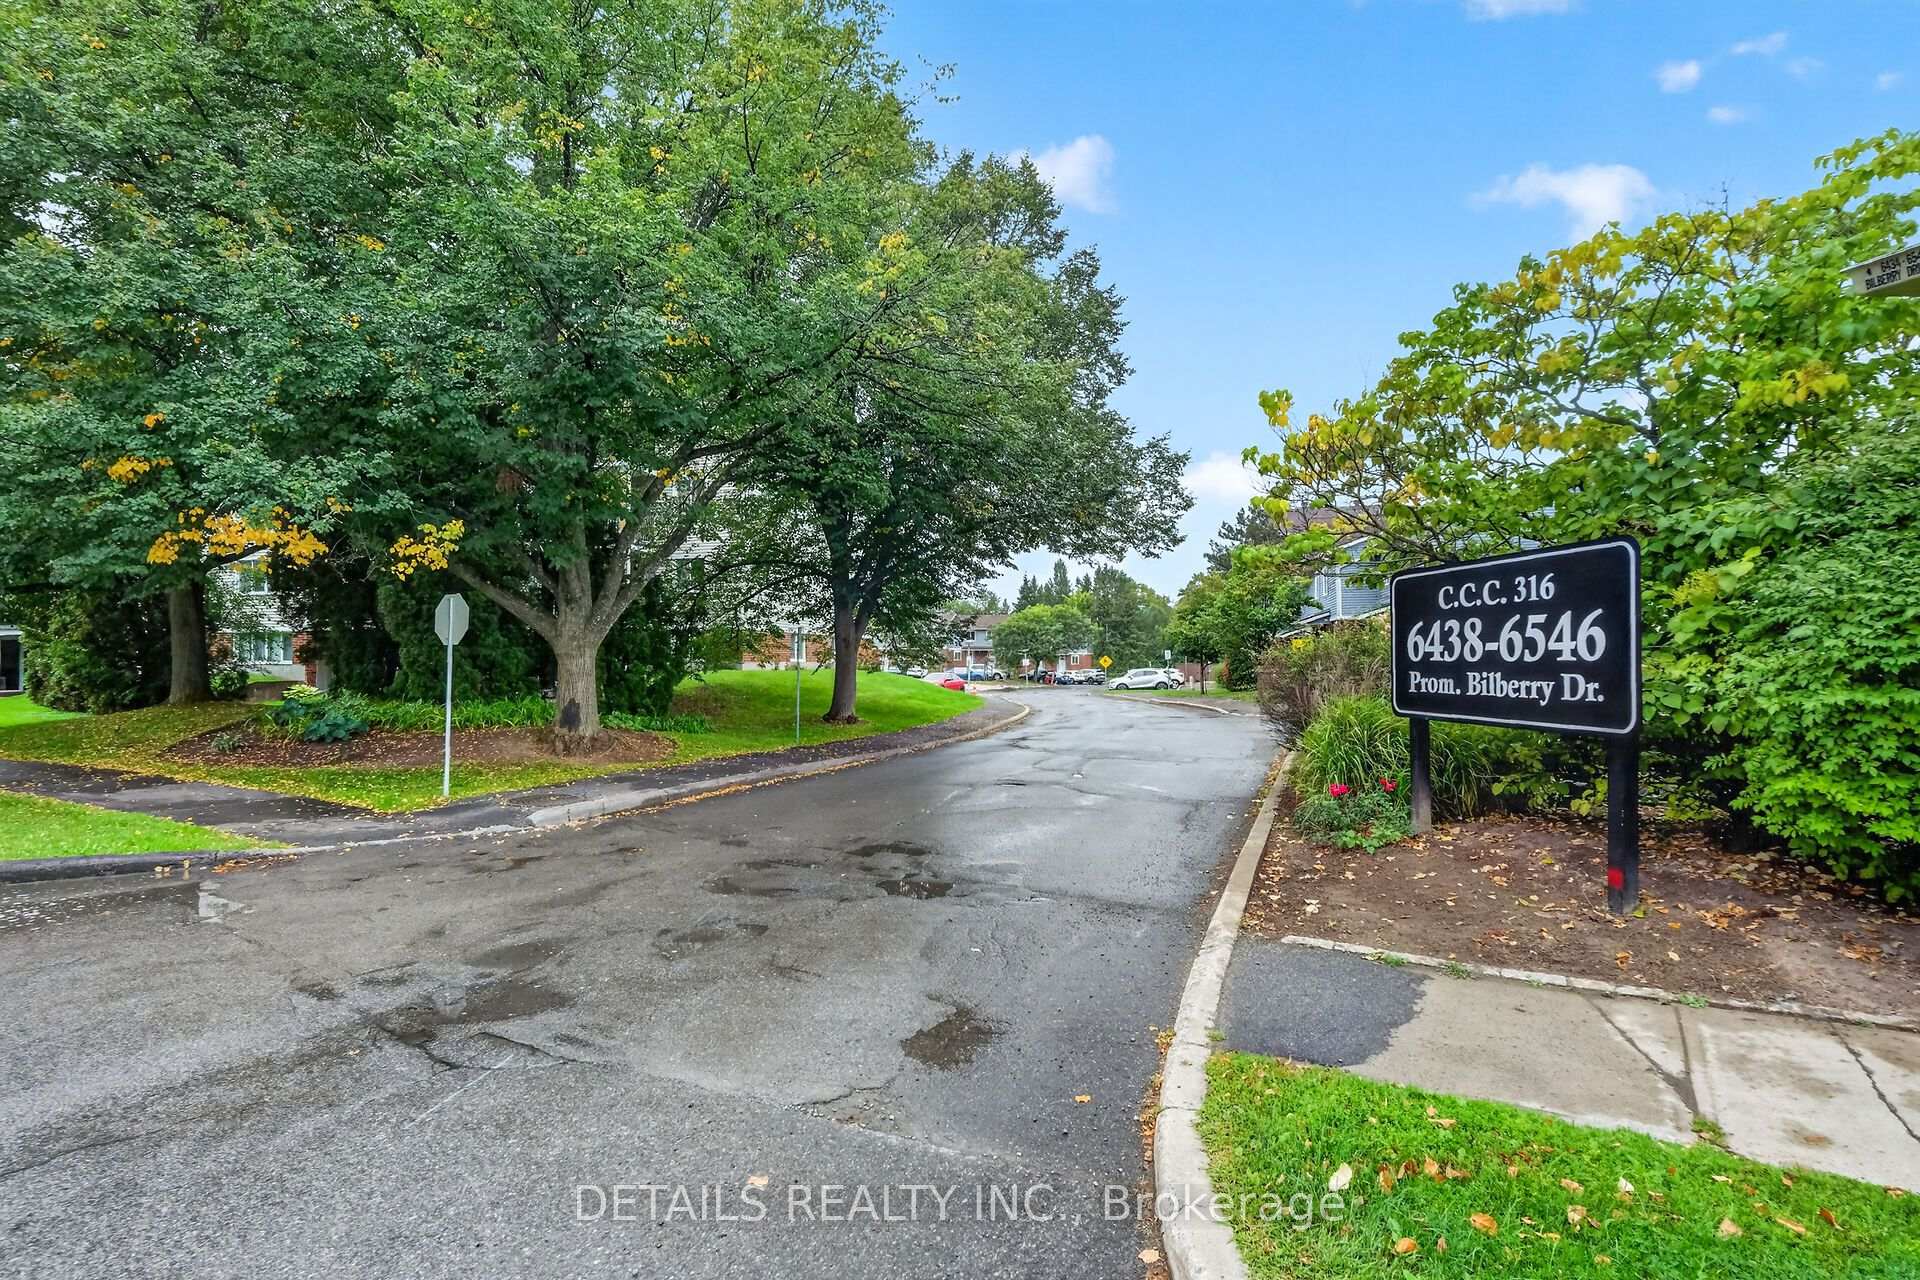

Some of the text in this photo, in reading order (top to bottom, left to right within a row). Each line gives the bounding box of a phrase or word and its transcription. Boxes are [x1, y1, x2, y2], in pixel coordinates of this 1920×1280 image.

[1438, 572, 1556, 610] C.C.C. 316
[1406, 608, 1607, 663] 6438-6546
[1408, 671, 1605, 707] Prom. Bilberry Dr.
